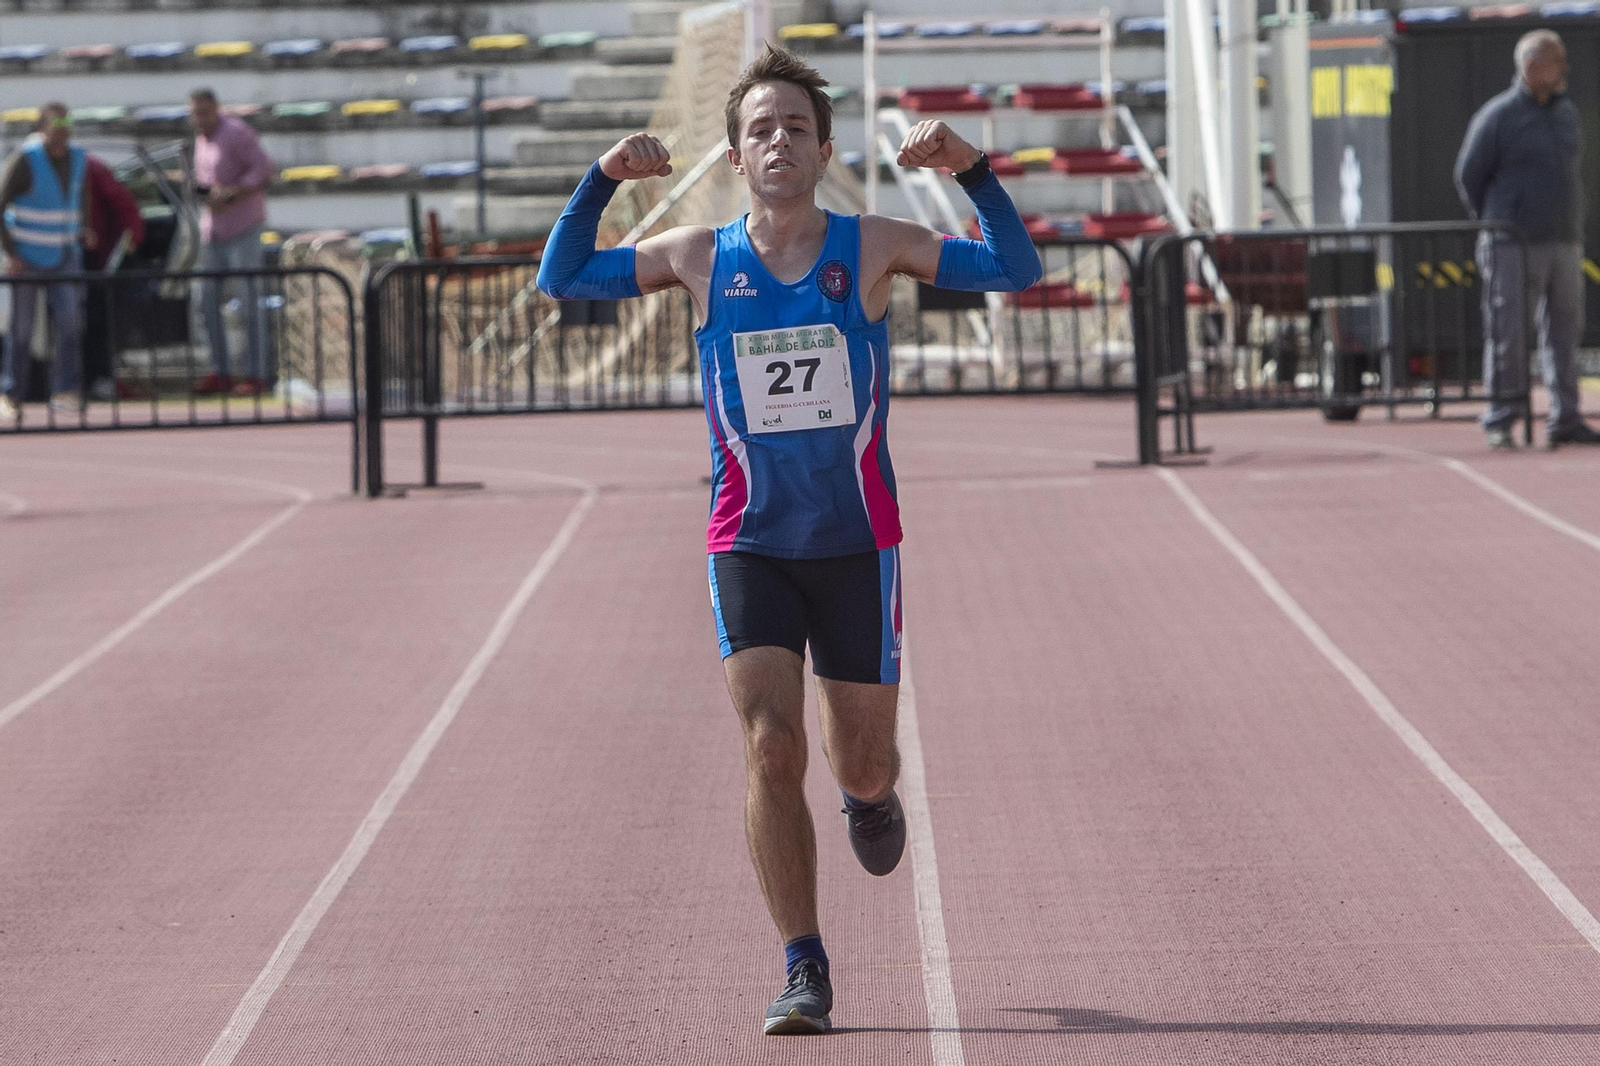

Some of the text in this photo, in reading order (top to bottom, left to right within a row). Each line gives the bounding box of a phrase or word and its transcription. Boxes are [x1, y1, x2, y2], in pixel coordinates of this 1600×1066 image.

[724, 288, 758, 297] VIATOR
[771, 332, 794, 341] MEDIA
[749, 338, 835, 355] BAHÍA DE CÁDIZ
[765, 357, 822, 396] 27
[818, 409, 832, 420] Dd
